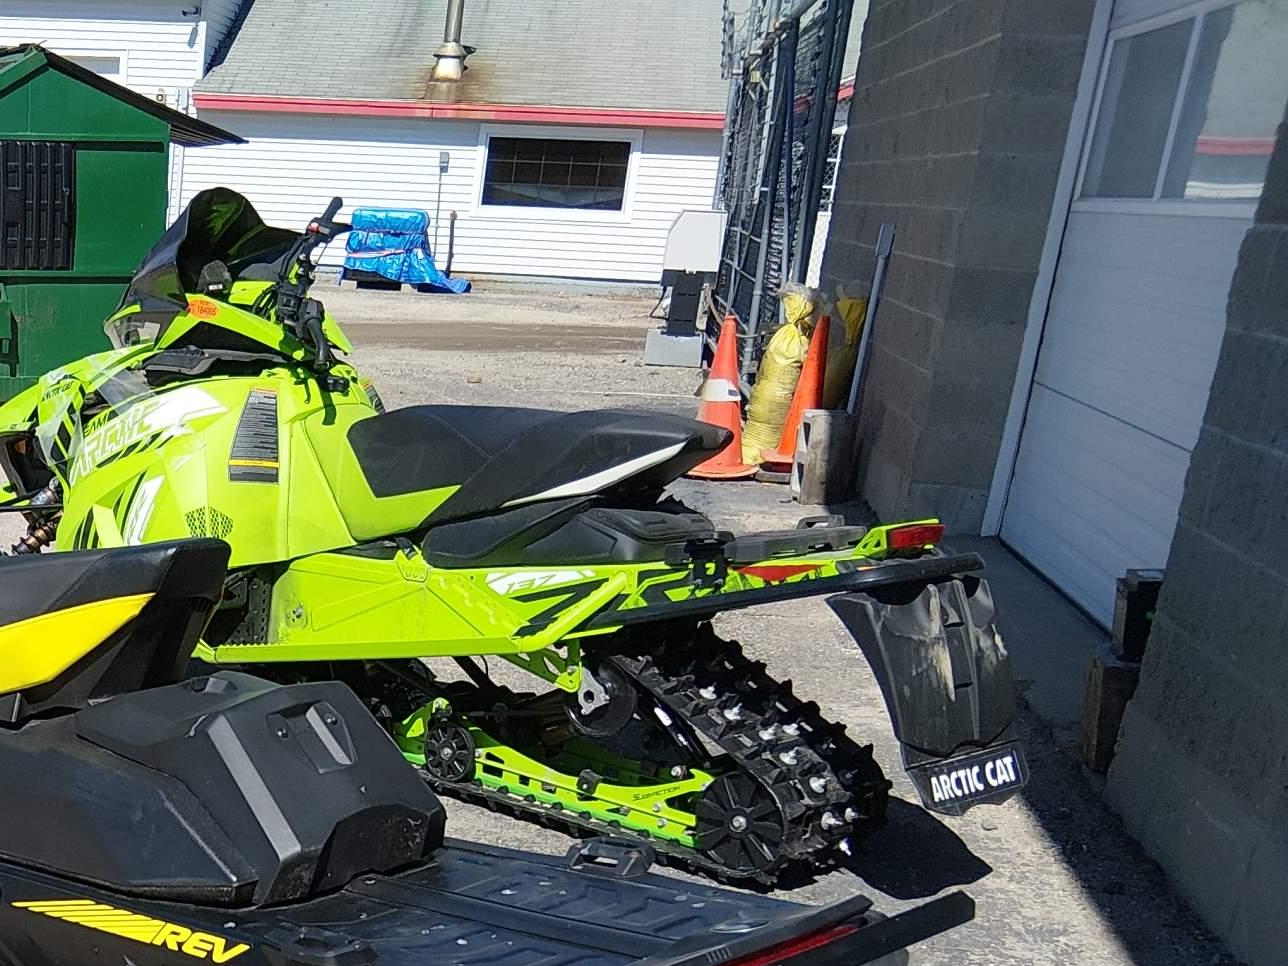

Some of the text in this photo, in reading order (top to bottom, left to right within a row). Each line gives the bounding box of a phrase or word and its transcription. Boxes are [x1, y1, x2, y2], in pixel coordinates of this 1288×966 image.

[930, 755, 1016, 803] ARCTIC CAT
[152, 922, 251, 963] REV
